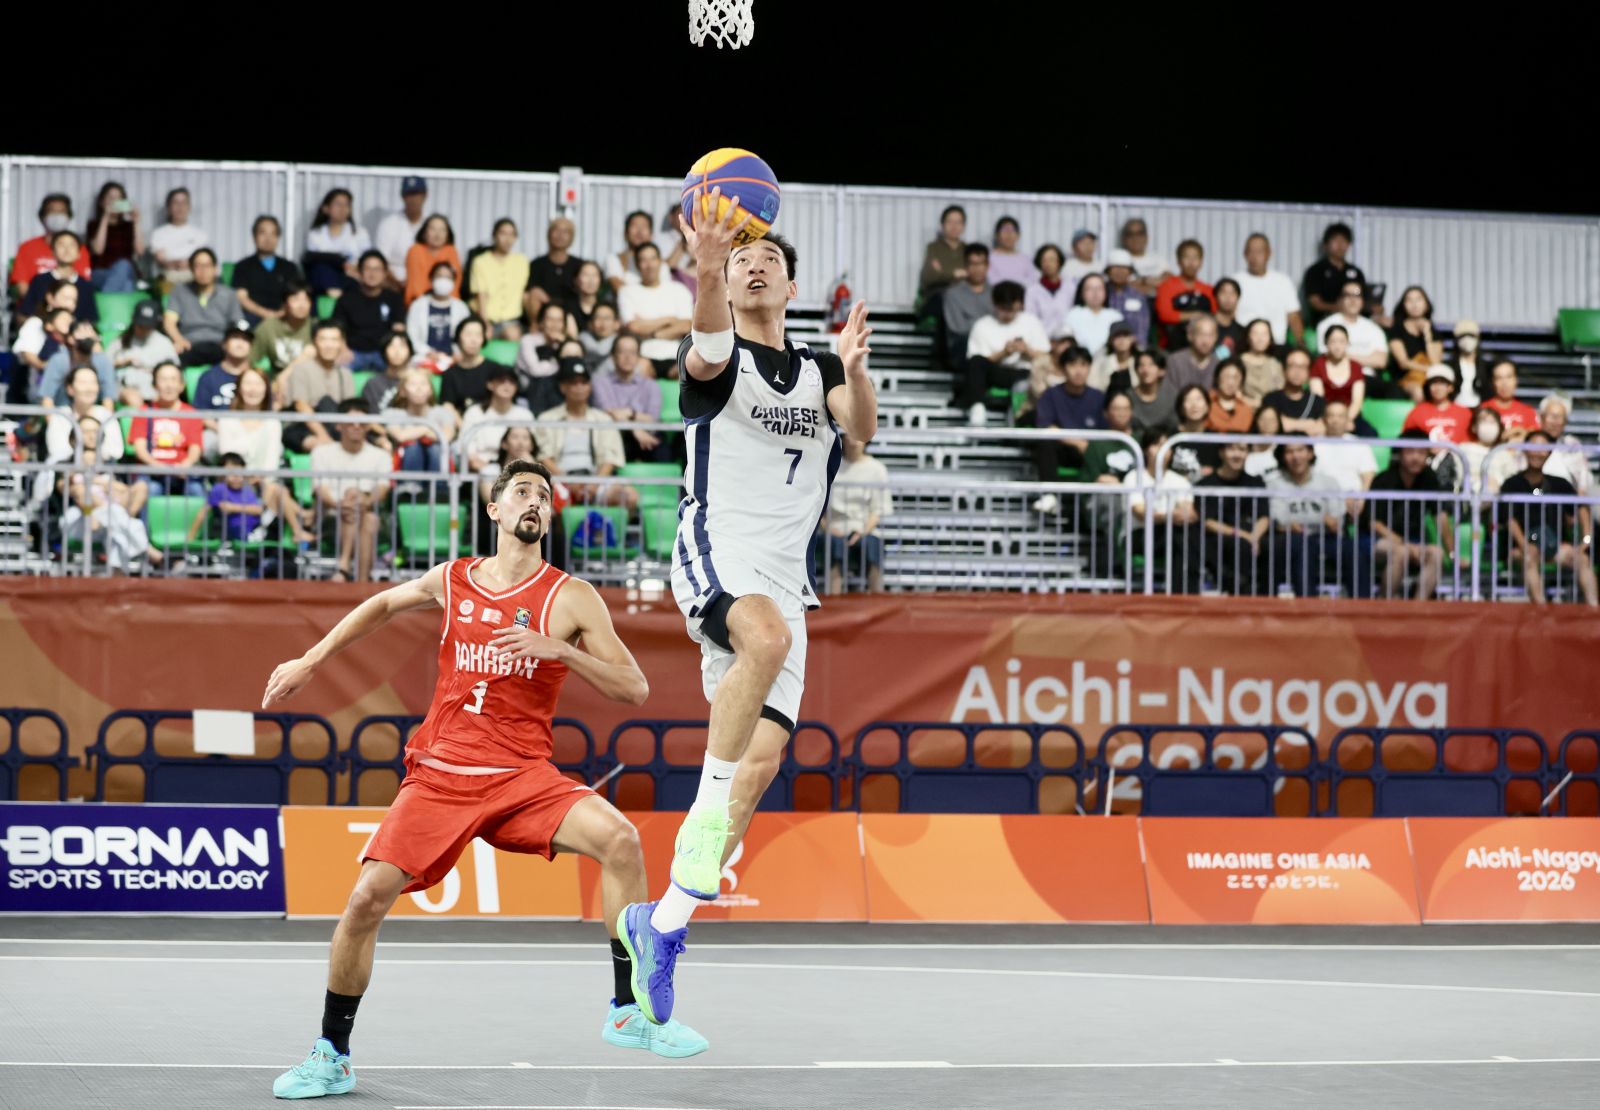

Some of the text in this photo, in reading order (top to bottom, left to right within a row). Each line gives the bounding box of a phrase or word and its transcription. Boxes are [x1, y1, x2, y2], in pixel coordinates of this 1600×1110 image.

[751, 405, 819, 425] CHINESE
[762, 420, 815, 438] TAIPEI
[784, 448, 803, 485] 7
[949, 658, 1449, 745] Aichi-Nagoya
[2, 825, 270, 867] BORNAN
[1186, 852, 1372, 870] IMAGINE ONE ASIA
[8, 869, 270, 890] SPORTS TECHNOLOGY
[1517, 870, 1577, 891] 2026
